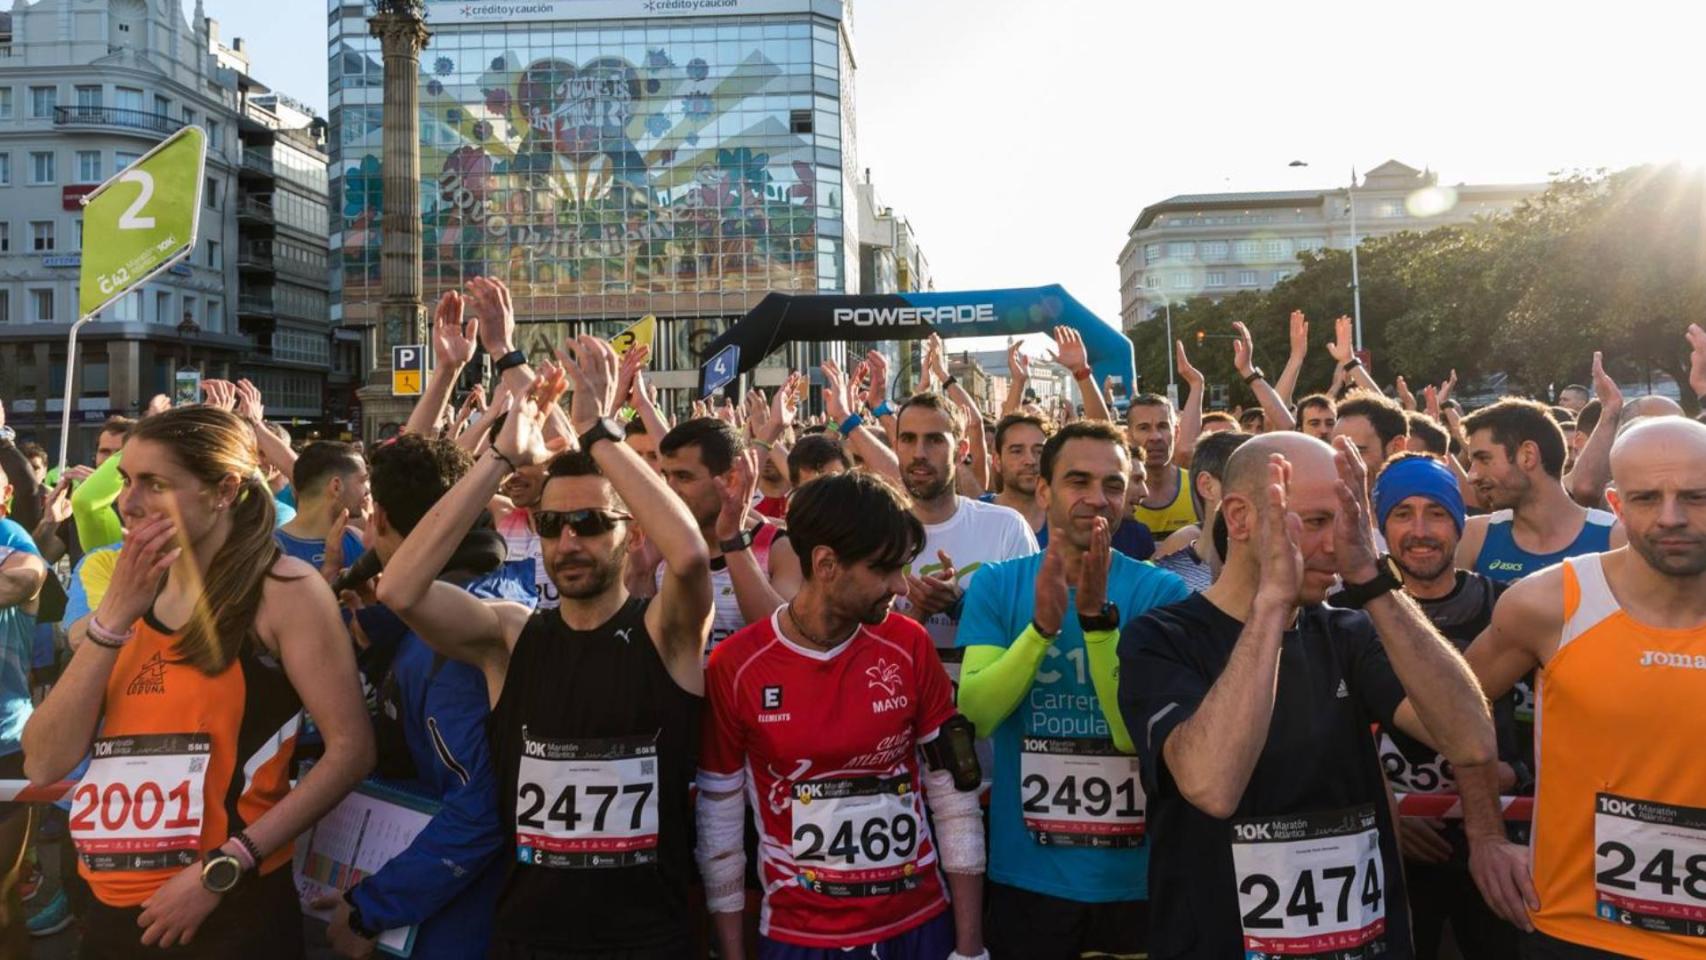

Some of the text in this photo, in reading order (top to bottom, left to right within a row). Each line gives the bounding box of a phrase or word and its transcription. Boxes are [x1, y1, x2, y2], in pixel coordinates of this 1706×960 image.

[118, 170, 156, 230] 2
[833, 303, 994, 326] POWERADE
[400, 349, 415, 368] P
[714, 357, 726, 375] 4
[764, 687, 780, 708] E
[872, 695, 908, 714] MAYO
[1030, 688, 1099, 711] Carrer
[758, 713, 791, 723] ELEMENTS
[1032, 711, 1108, 738] Popula
[94, 742, 115, 757] 10K
[525, 740, 545, 757] 10K
[1024, 739, 1048, 752] 10K
[794, 784, 823, 797] 10K
[1022, 774, 1144, 817] 2491
[70, 780, 200, 831] 2001
[518, 782, 654, 831] 2477
[1600, 798, 1636, 817] 10K
[793, 813, 917, 864] 2469
[1234, 819, 1308, 840] 10K Maratón
[1596, 841, 1706, 901] 248
[1239, 858, 1382, 929] 2474
